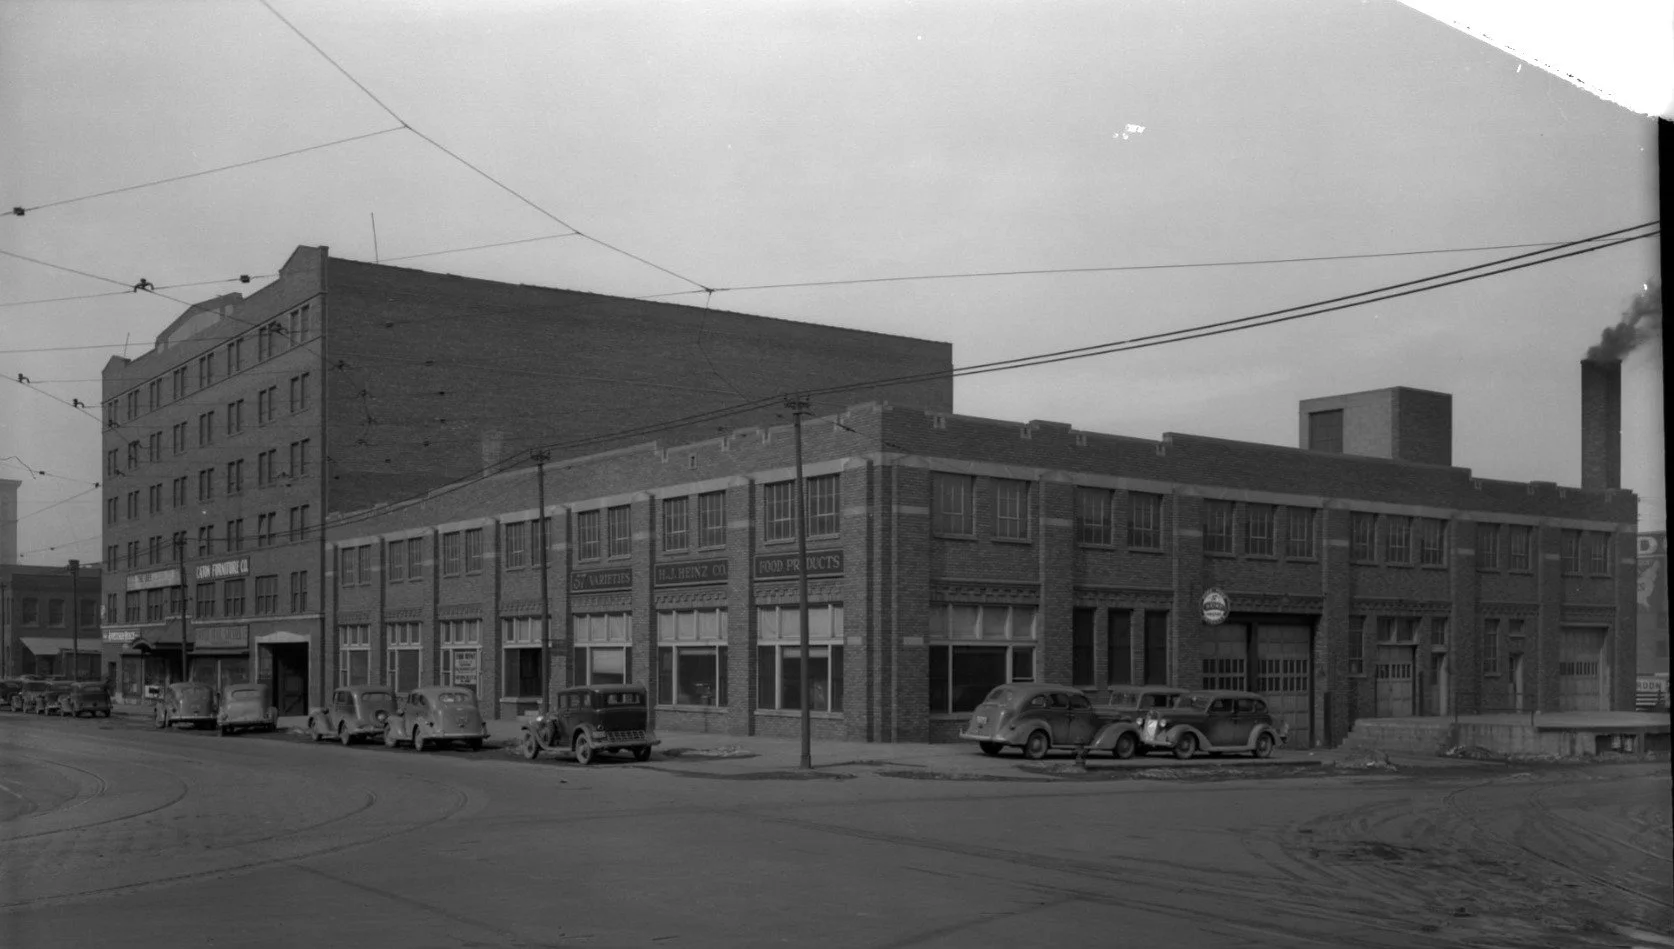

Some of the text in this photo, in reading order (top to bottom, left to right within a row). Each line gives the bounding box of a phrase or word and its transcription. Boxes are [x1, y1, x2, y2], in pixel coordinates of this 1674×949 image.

[759, 555, 840, 574] FOOD PRDUCTS
[588, 572, 631, 587] VARIETIES
